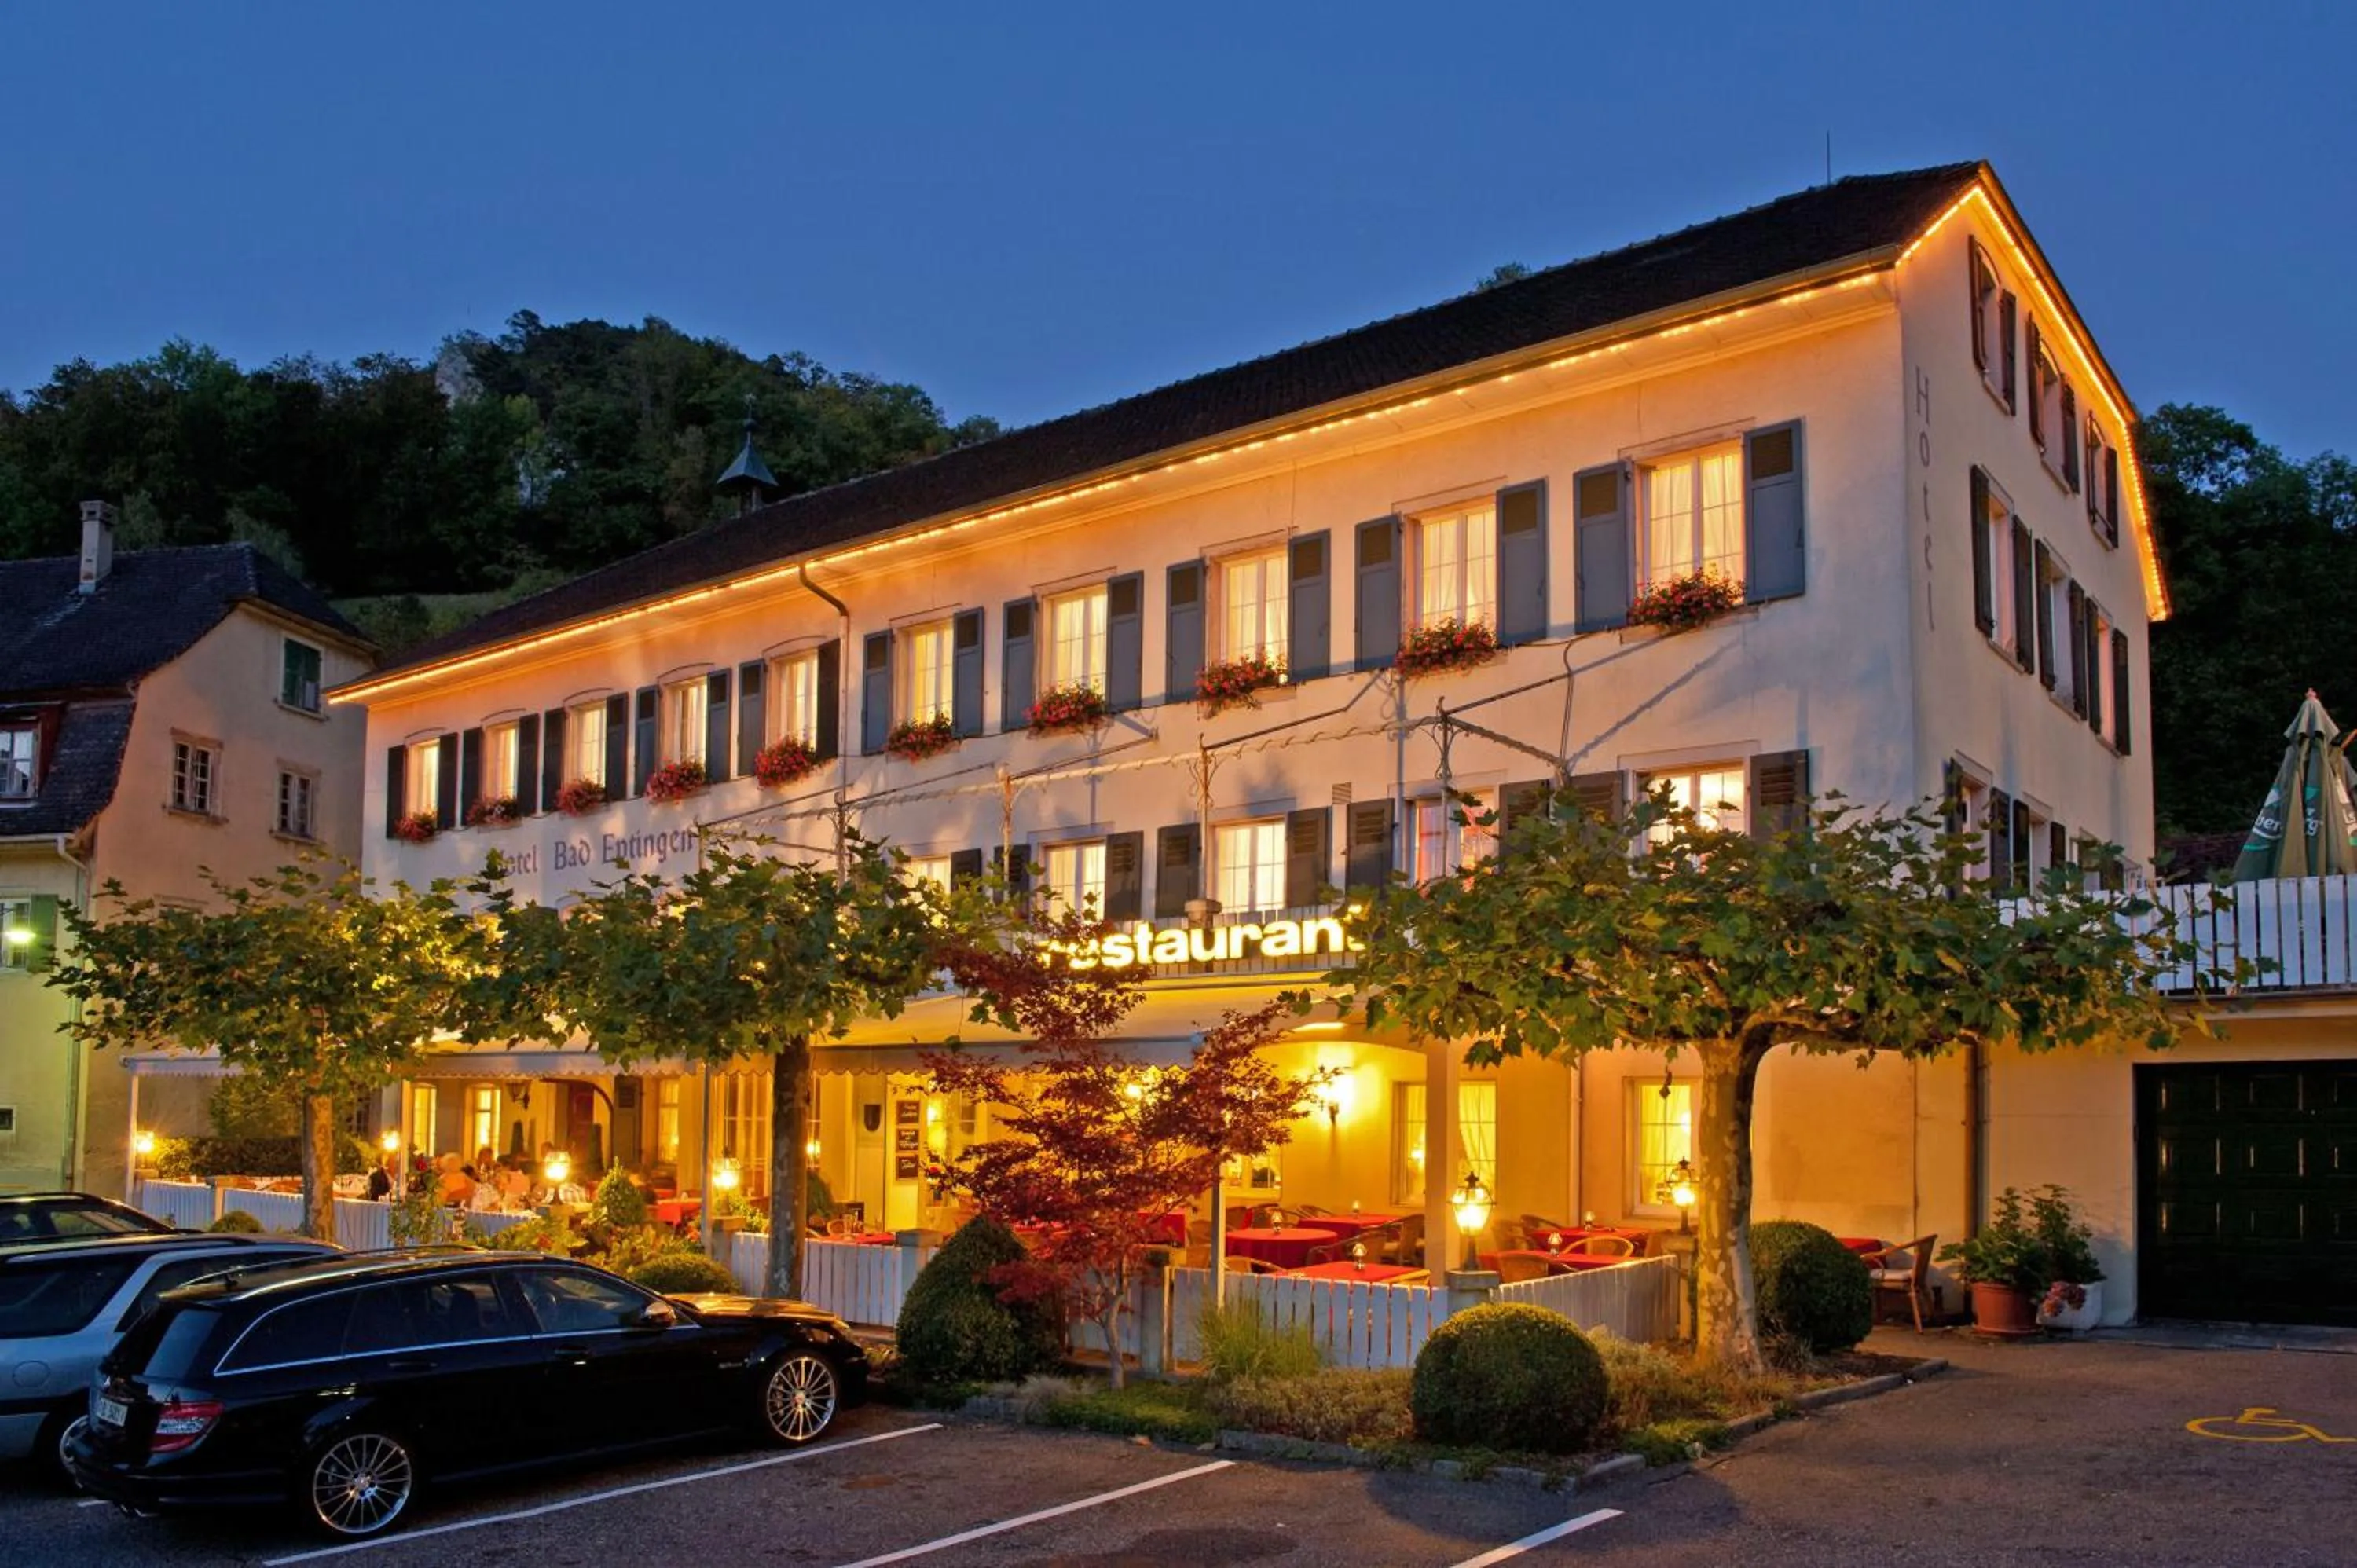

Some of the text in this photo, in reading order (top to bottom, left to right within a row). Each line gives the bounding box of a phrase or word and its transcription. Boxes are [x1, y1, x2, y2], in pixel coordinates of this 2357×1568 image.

[1915, 365, 1935, 632] Hotel
[495, 828, 695, 876] otel Bad Eptingen
